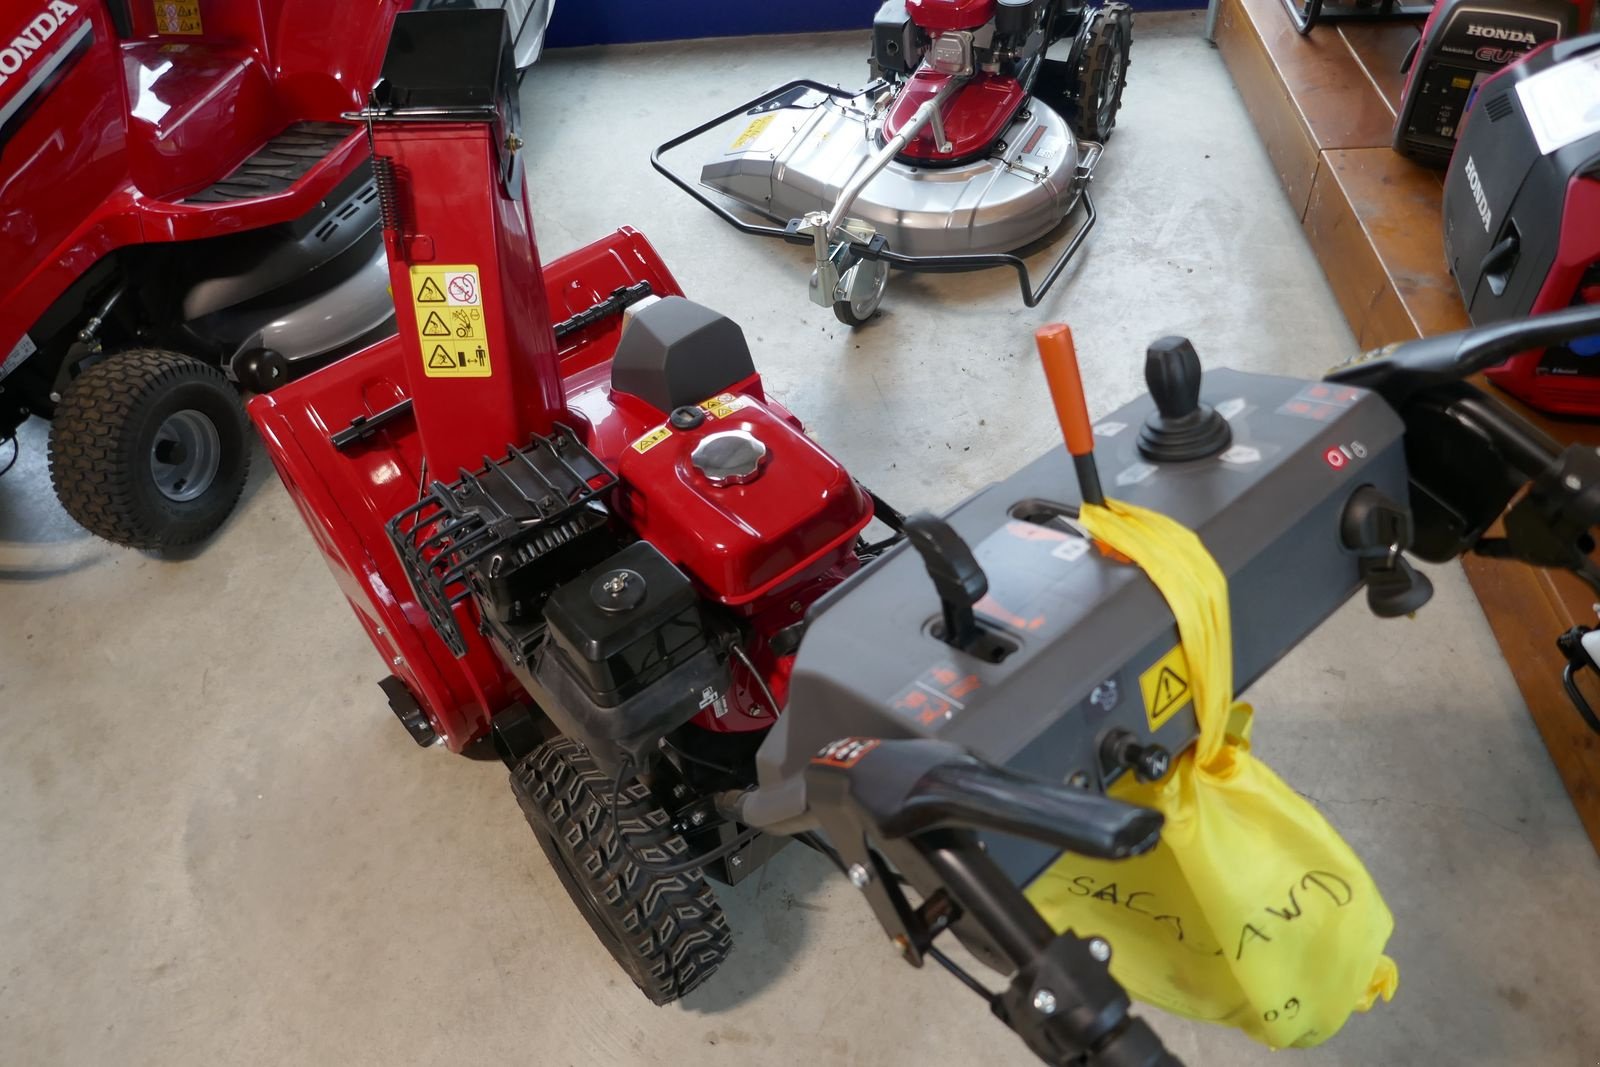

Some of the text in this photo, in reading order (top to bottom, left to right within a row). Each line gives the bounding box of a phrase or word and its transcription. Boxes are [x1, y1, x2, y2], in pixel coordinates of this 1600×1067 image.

[0, 0, 78, 87] ONDA
[1466, 24, 1537, 44] HONDA
[1464, 154, 1492, 233] HONDA
[1236, 870, 1353, 961] AWD
